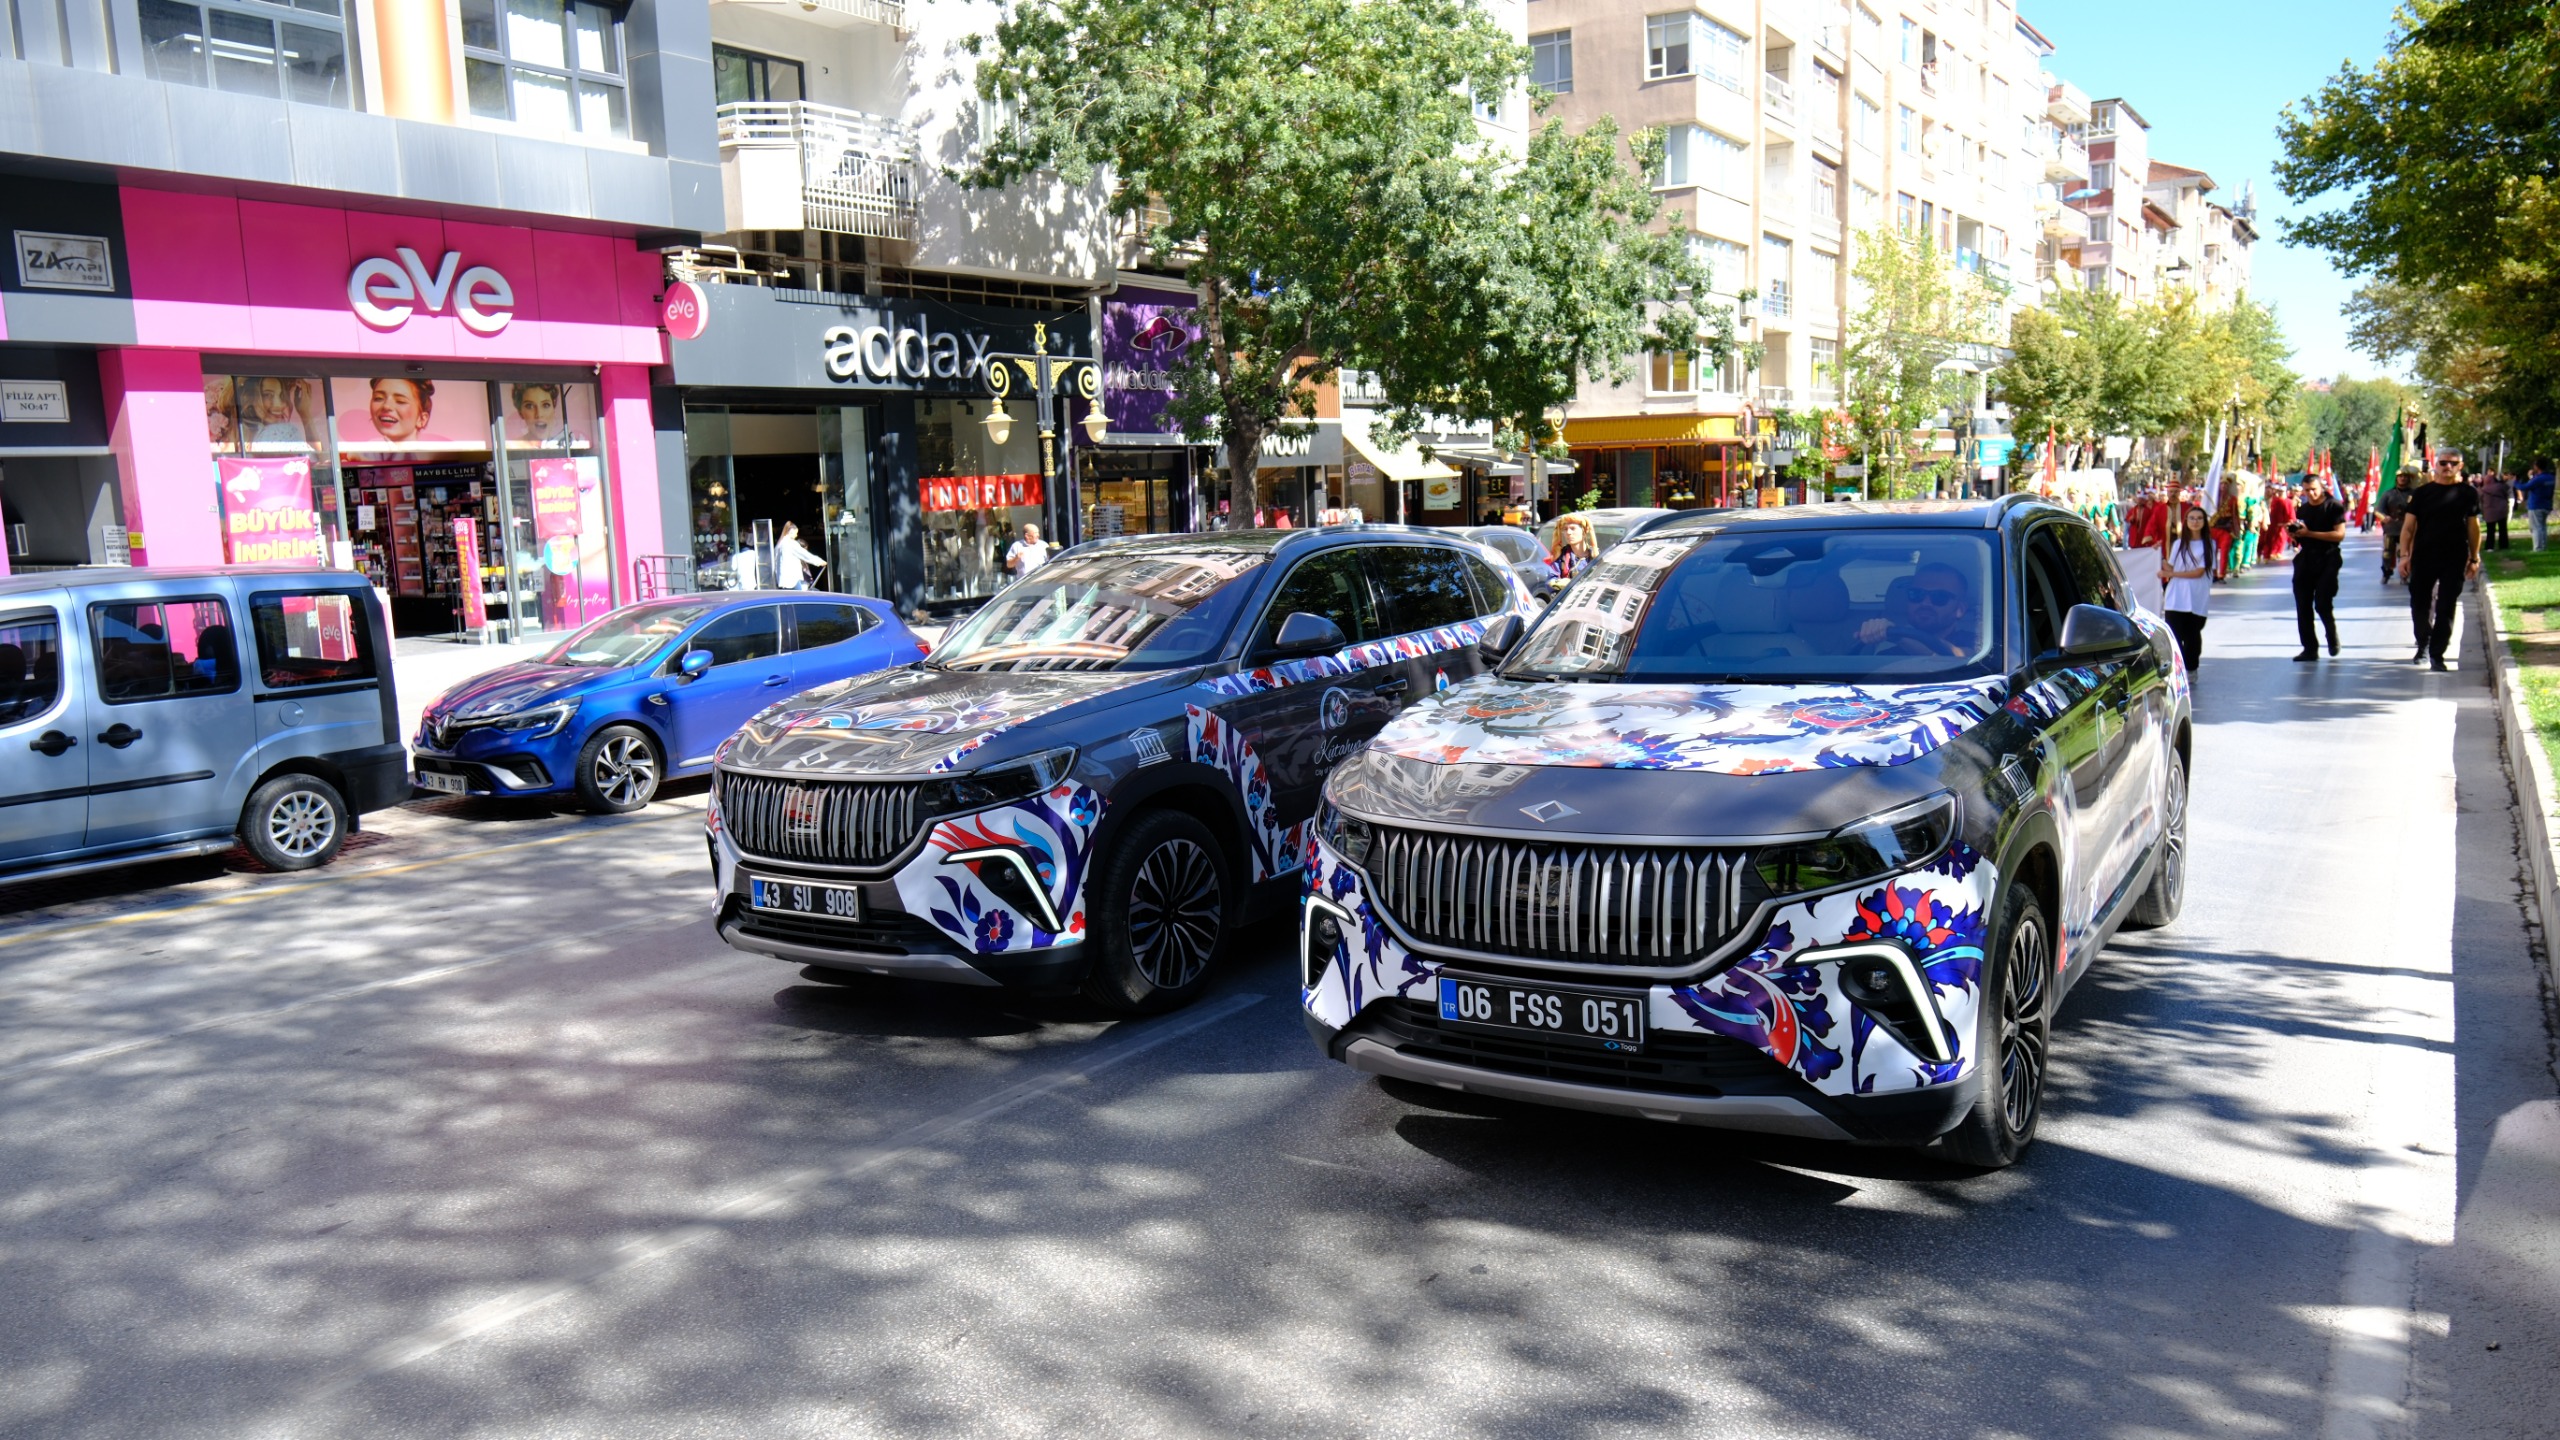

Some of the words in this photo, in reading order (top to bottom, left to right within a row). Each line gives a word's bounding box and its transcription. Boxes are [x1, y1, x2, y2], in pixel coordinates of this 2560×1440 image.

[64, 261, 103, 273] YAPI
[348, 247, 515, 332] eve
[667, 298, 694, 320] eve
[824, 309, 991, 379] addax
[20, 402, 49, 411] NO:47
[36, 393, 61, 401] APT.
[415, 467, 476, 477] MAYBELLINE
[1348, 462, 1376, 478] BİRTAT
[928, 479, 1024, 508] İNDİRİM
[229, 506, 312, 534] BÜYÜK
[234, 537, 318, 563] İNDİRİM
[322, 625, 342, 641] eve
[763, 882, 781, 908] 43
[793, 885, 812, 912] SU
[825, 888, 855, 917] 908
[1444, 1002, 1456, 1013] TR
[1458, 985, 1492, 1020] 06
[1509, 991, 1563, 1029] FSS
[1582, 999, 1635, 1038] 051
[1620, 1043, 1638, 1052] Togg
